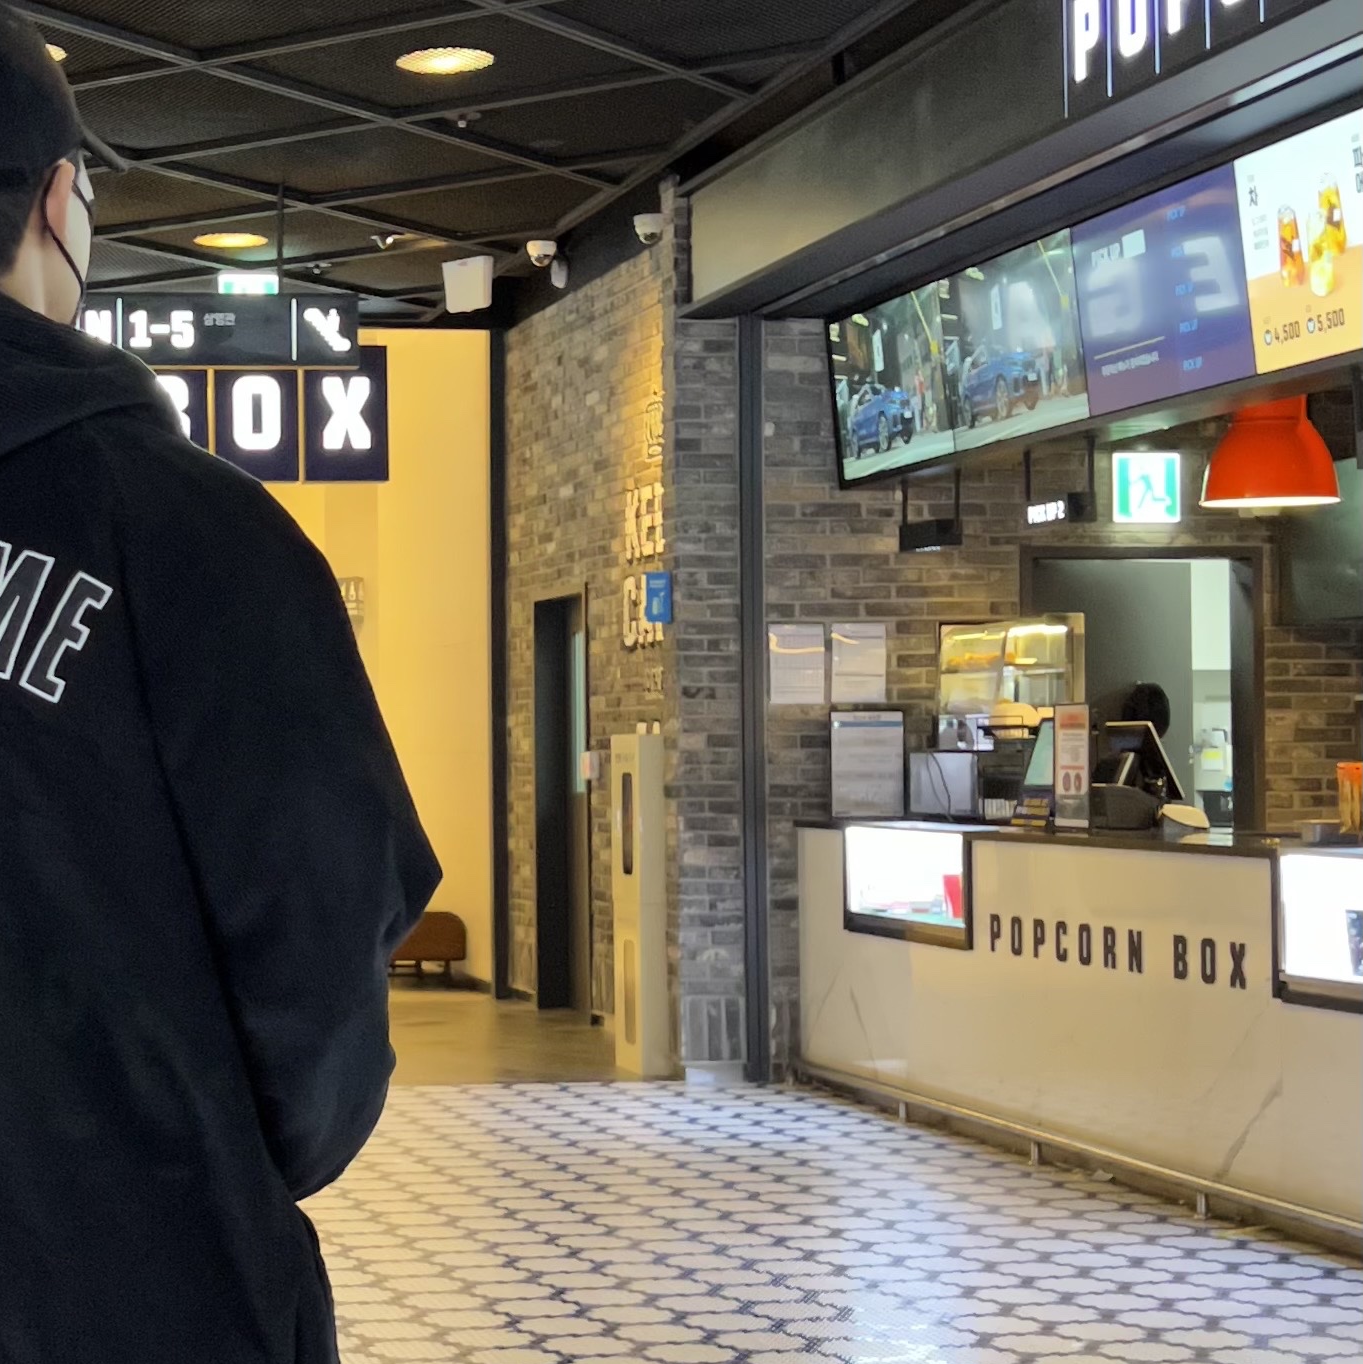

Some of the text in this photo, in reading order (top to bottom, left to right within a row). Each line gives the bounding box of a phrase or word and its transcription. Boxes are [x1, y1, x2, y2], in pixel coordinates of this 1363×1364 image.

[128, 309, 196, 349] 1-5
[989, 913, 1247, 990] POPCORN BOX
